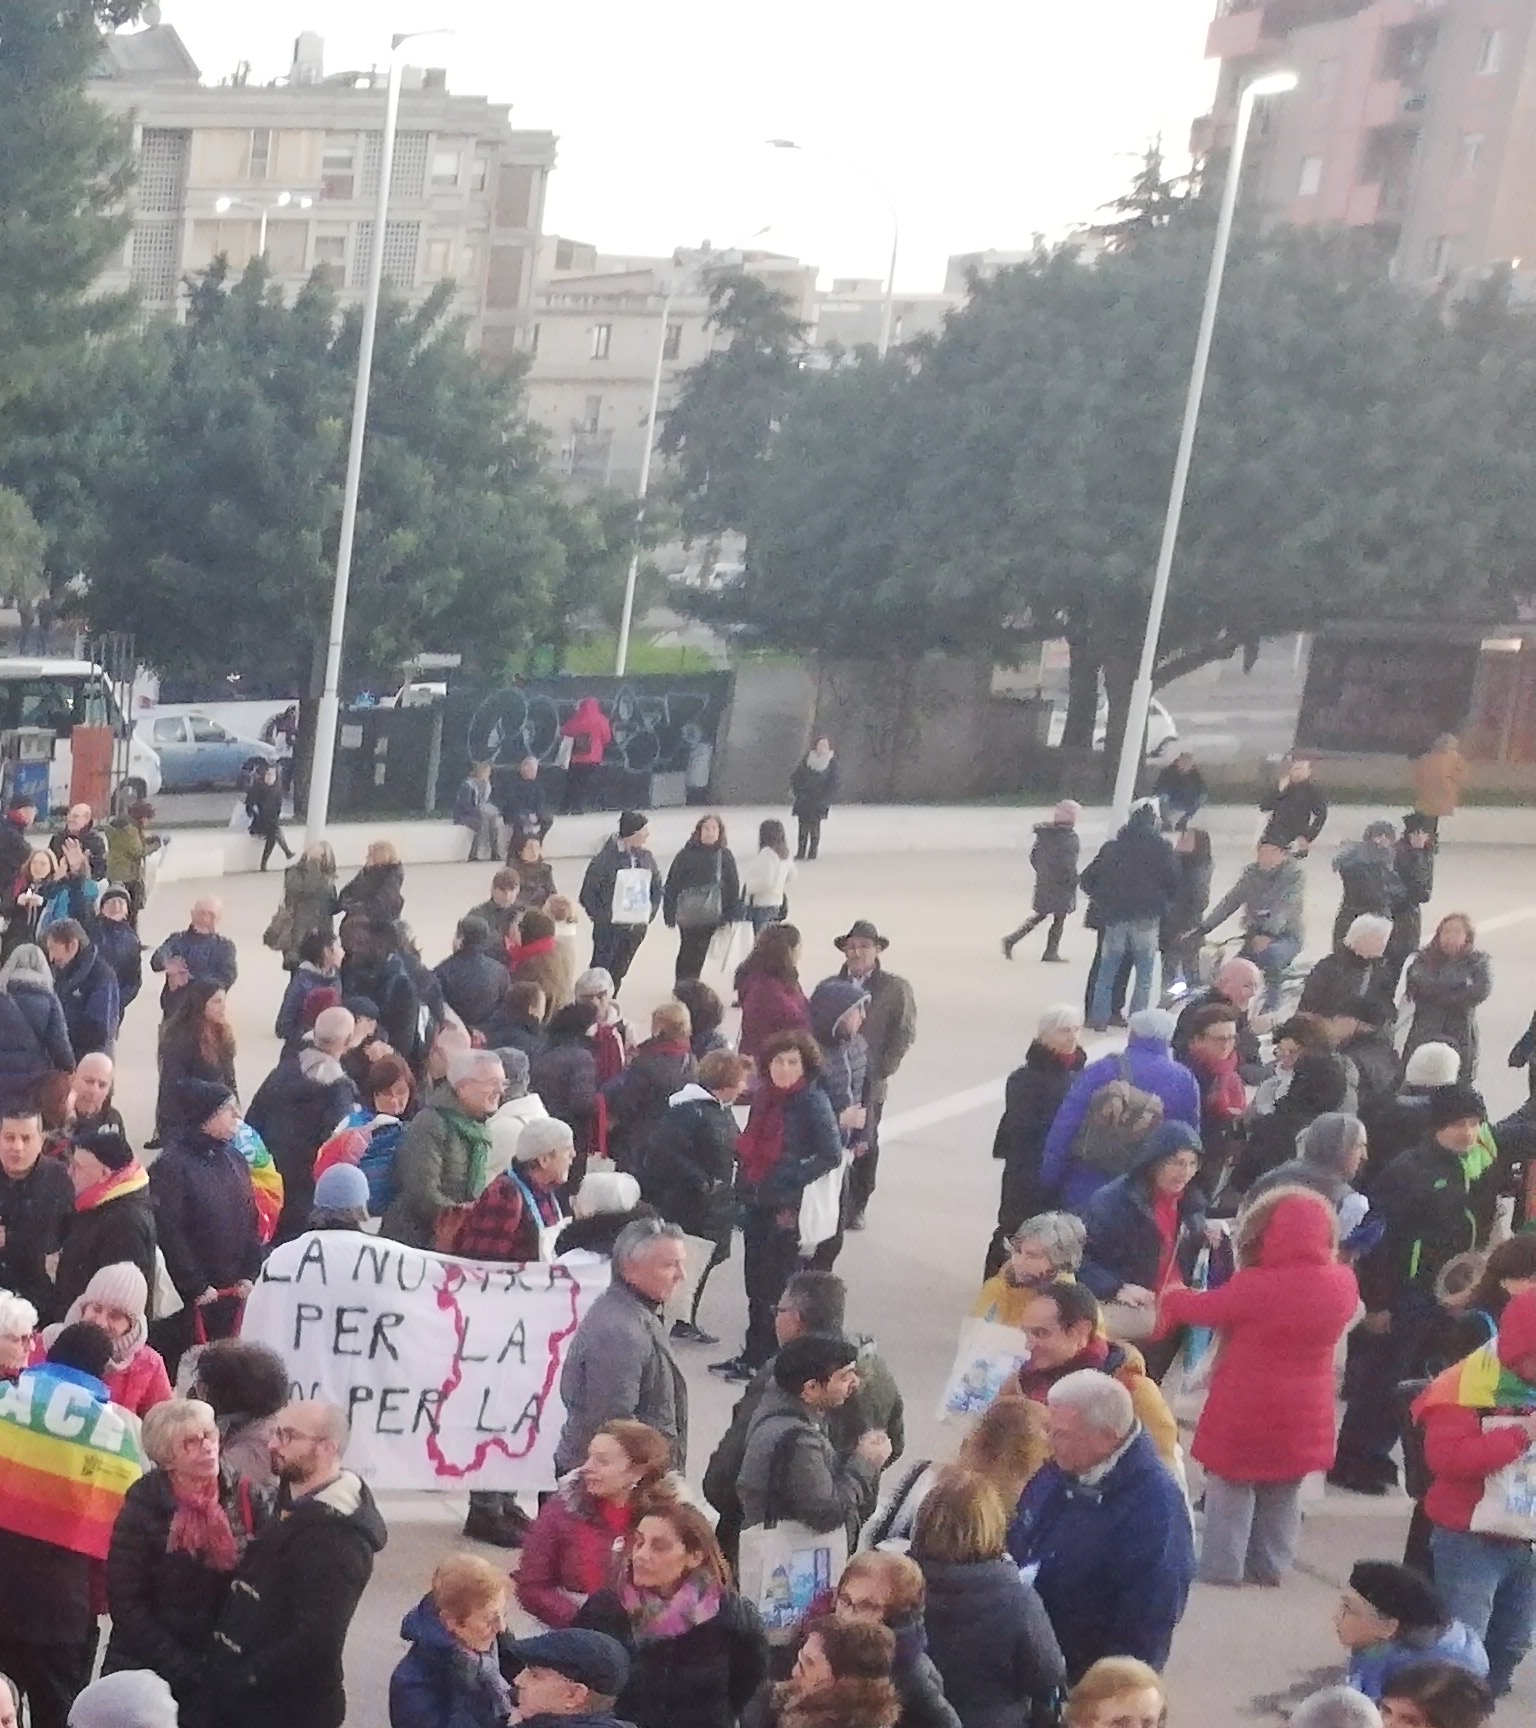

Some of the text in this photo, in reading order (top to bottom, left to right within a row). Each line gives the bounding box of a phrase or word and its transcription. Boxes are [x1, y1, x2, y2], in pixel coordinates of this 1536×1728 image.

[261, 1236, 327, 1286] LA
[293, 1303, 527, 1364] PER LA
[348, 1385, 441, 1435] PER
[476, 1386, 542, 1434] LA
